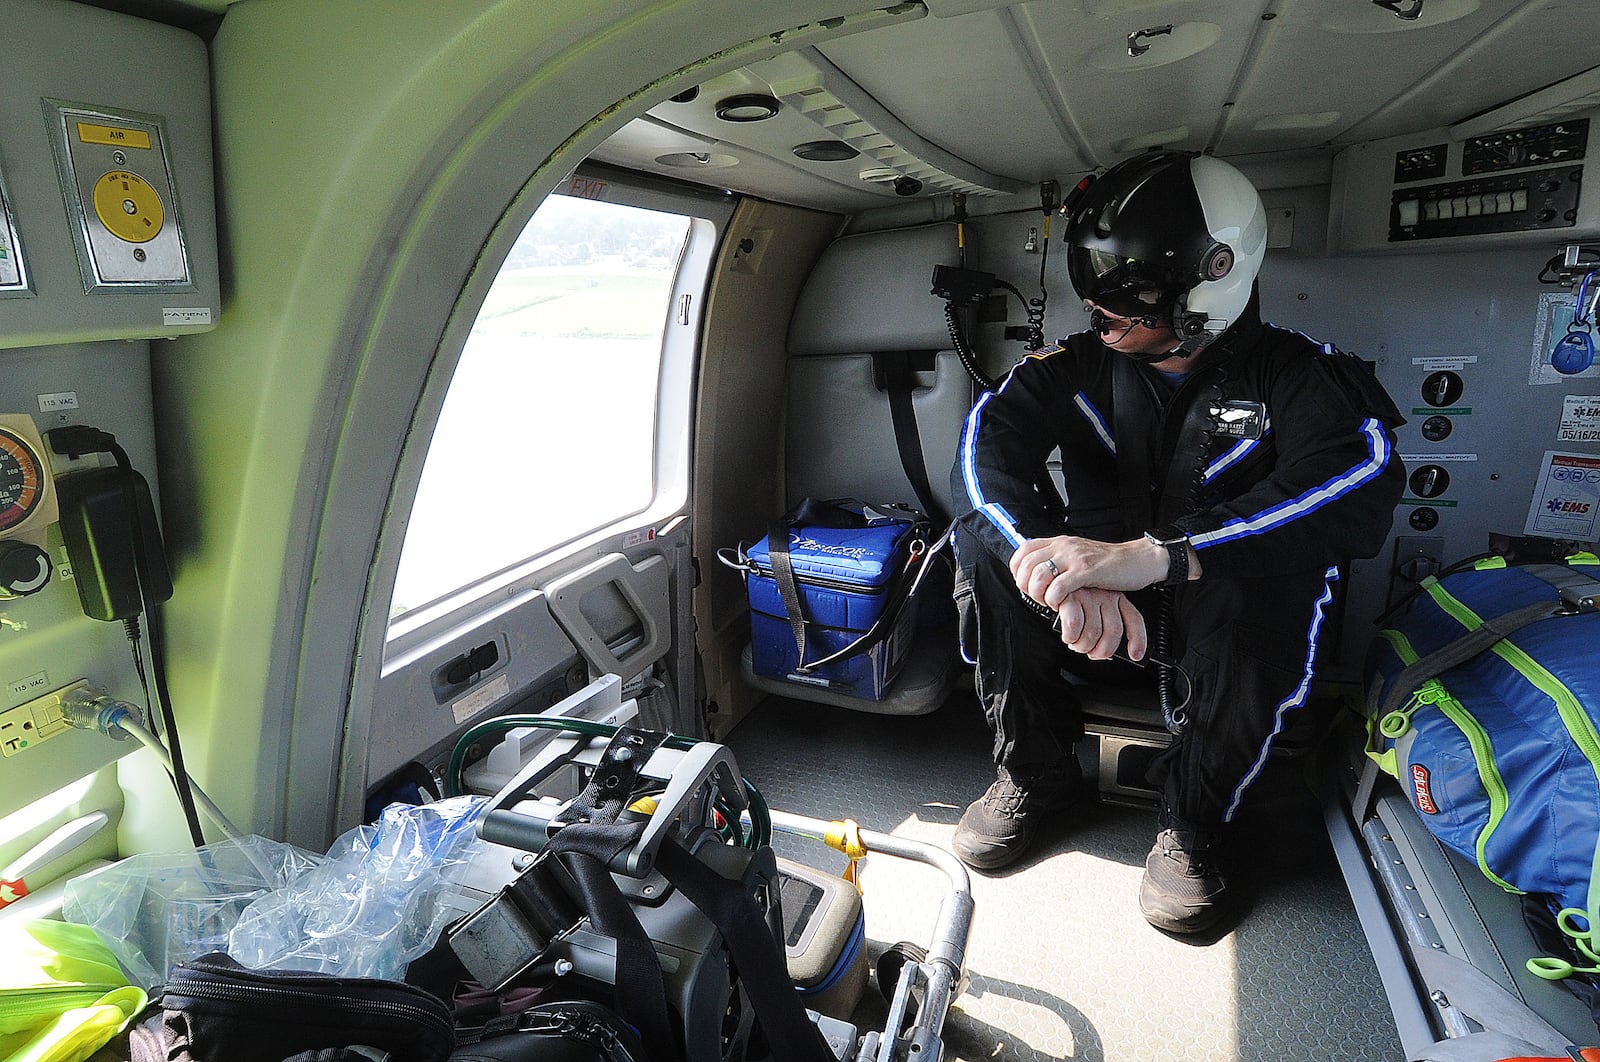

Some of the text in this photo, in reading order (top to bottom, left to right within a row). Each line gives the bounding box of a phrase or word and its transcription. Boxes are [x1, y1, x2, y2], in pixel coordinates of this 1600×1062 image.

[110, 131, 125, 140] AIR
[571, 178, 607, 198] EXIT
[43, 399, 56, 407] 115
[1586, 408, 1600, 417] EM
[1562, 430, 1600, 440] 05/16/20
[0, 454, 8, 462] 40
[6, 468, 19, 476] 160
[1, 497, 14, 505] 200
[1561, 501, 1591, 513] EMS
[14, 678, 44, 693] 115 VAC
